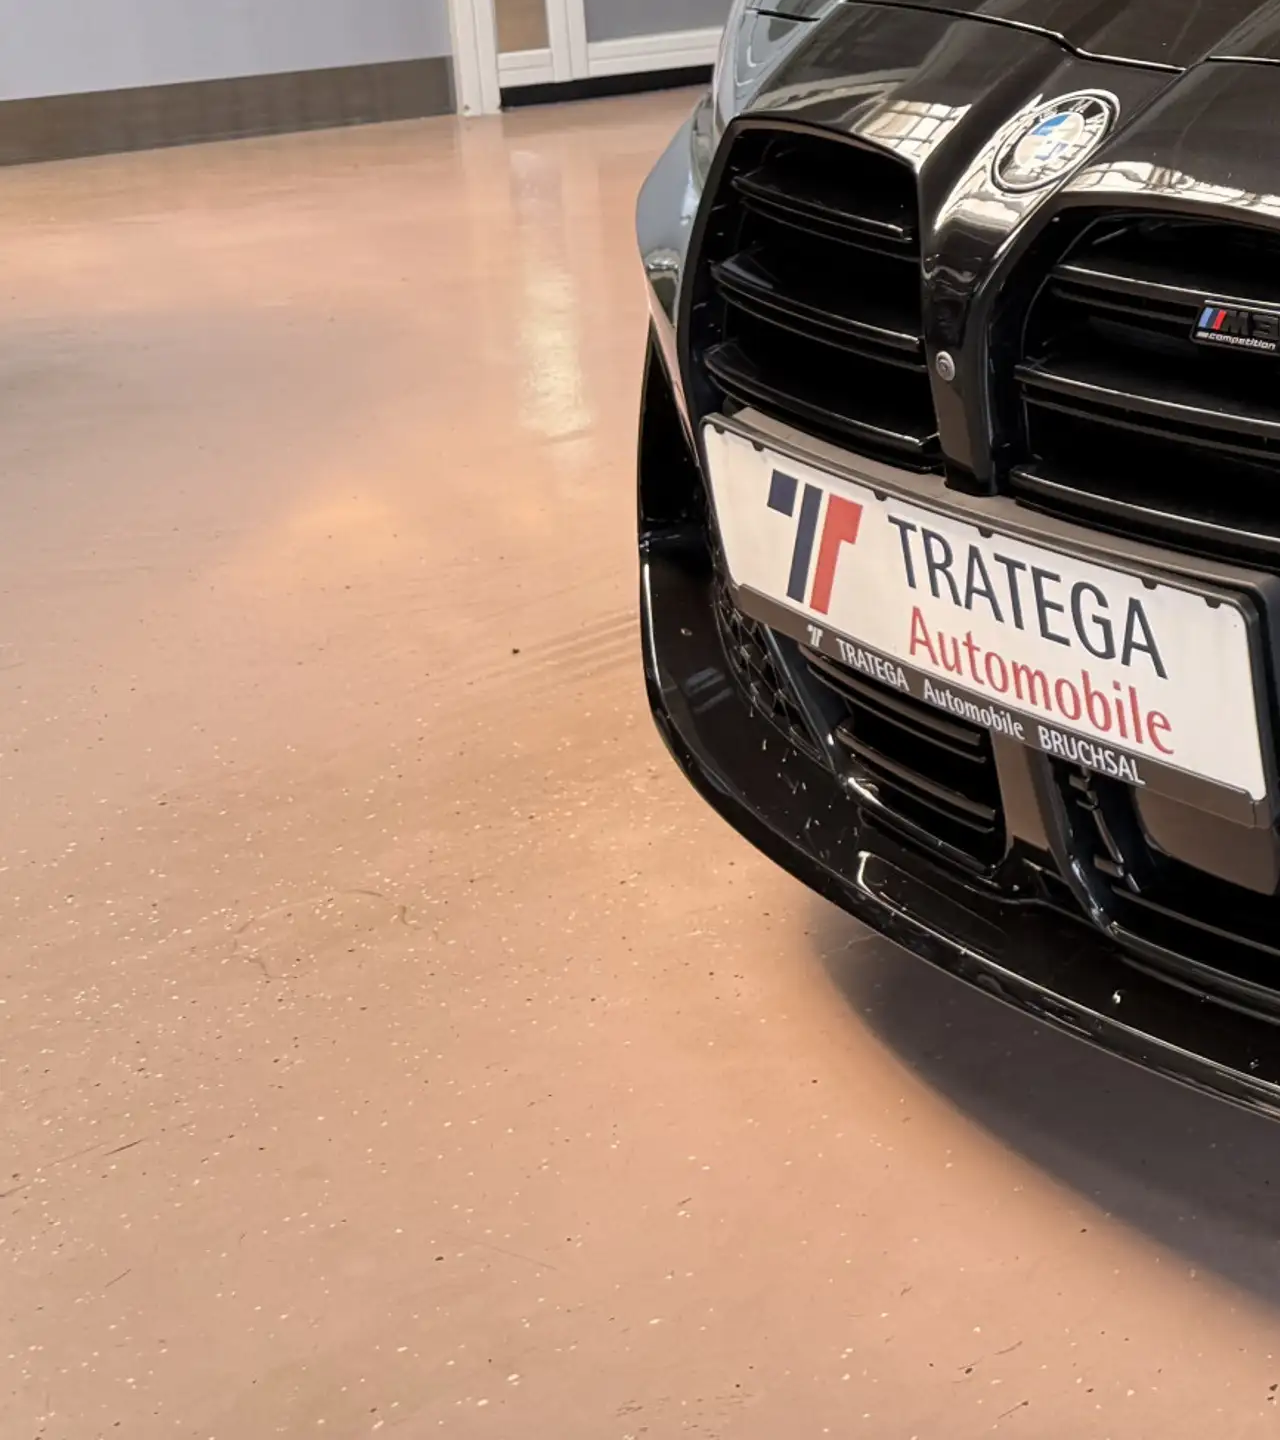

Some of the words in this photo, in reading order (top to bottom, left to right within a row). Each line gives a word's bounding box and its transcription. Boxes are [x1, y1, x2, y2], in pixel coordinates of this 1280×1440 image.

[887, 514, 1168, 679] TRATEGA
[836, 637, 911, 692] TRATEGA
[922, 678, 1026, 742] Automobile
[1037, 725, 1146, 786] BRUCHSAL
[908, 605, 1174, 755] Automobile
